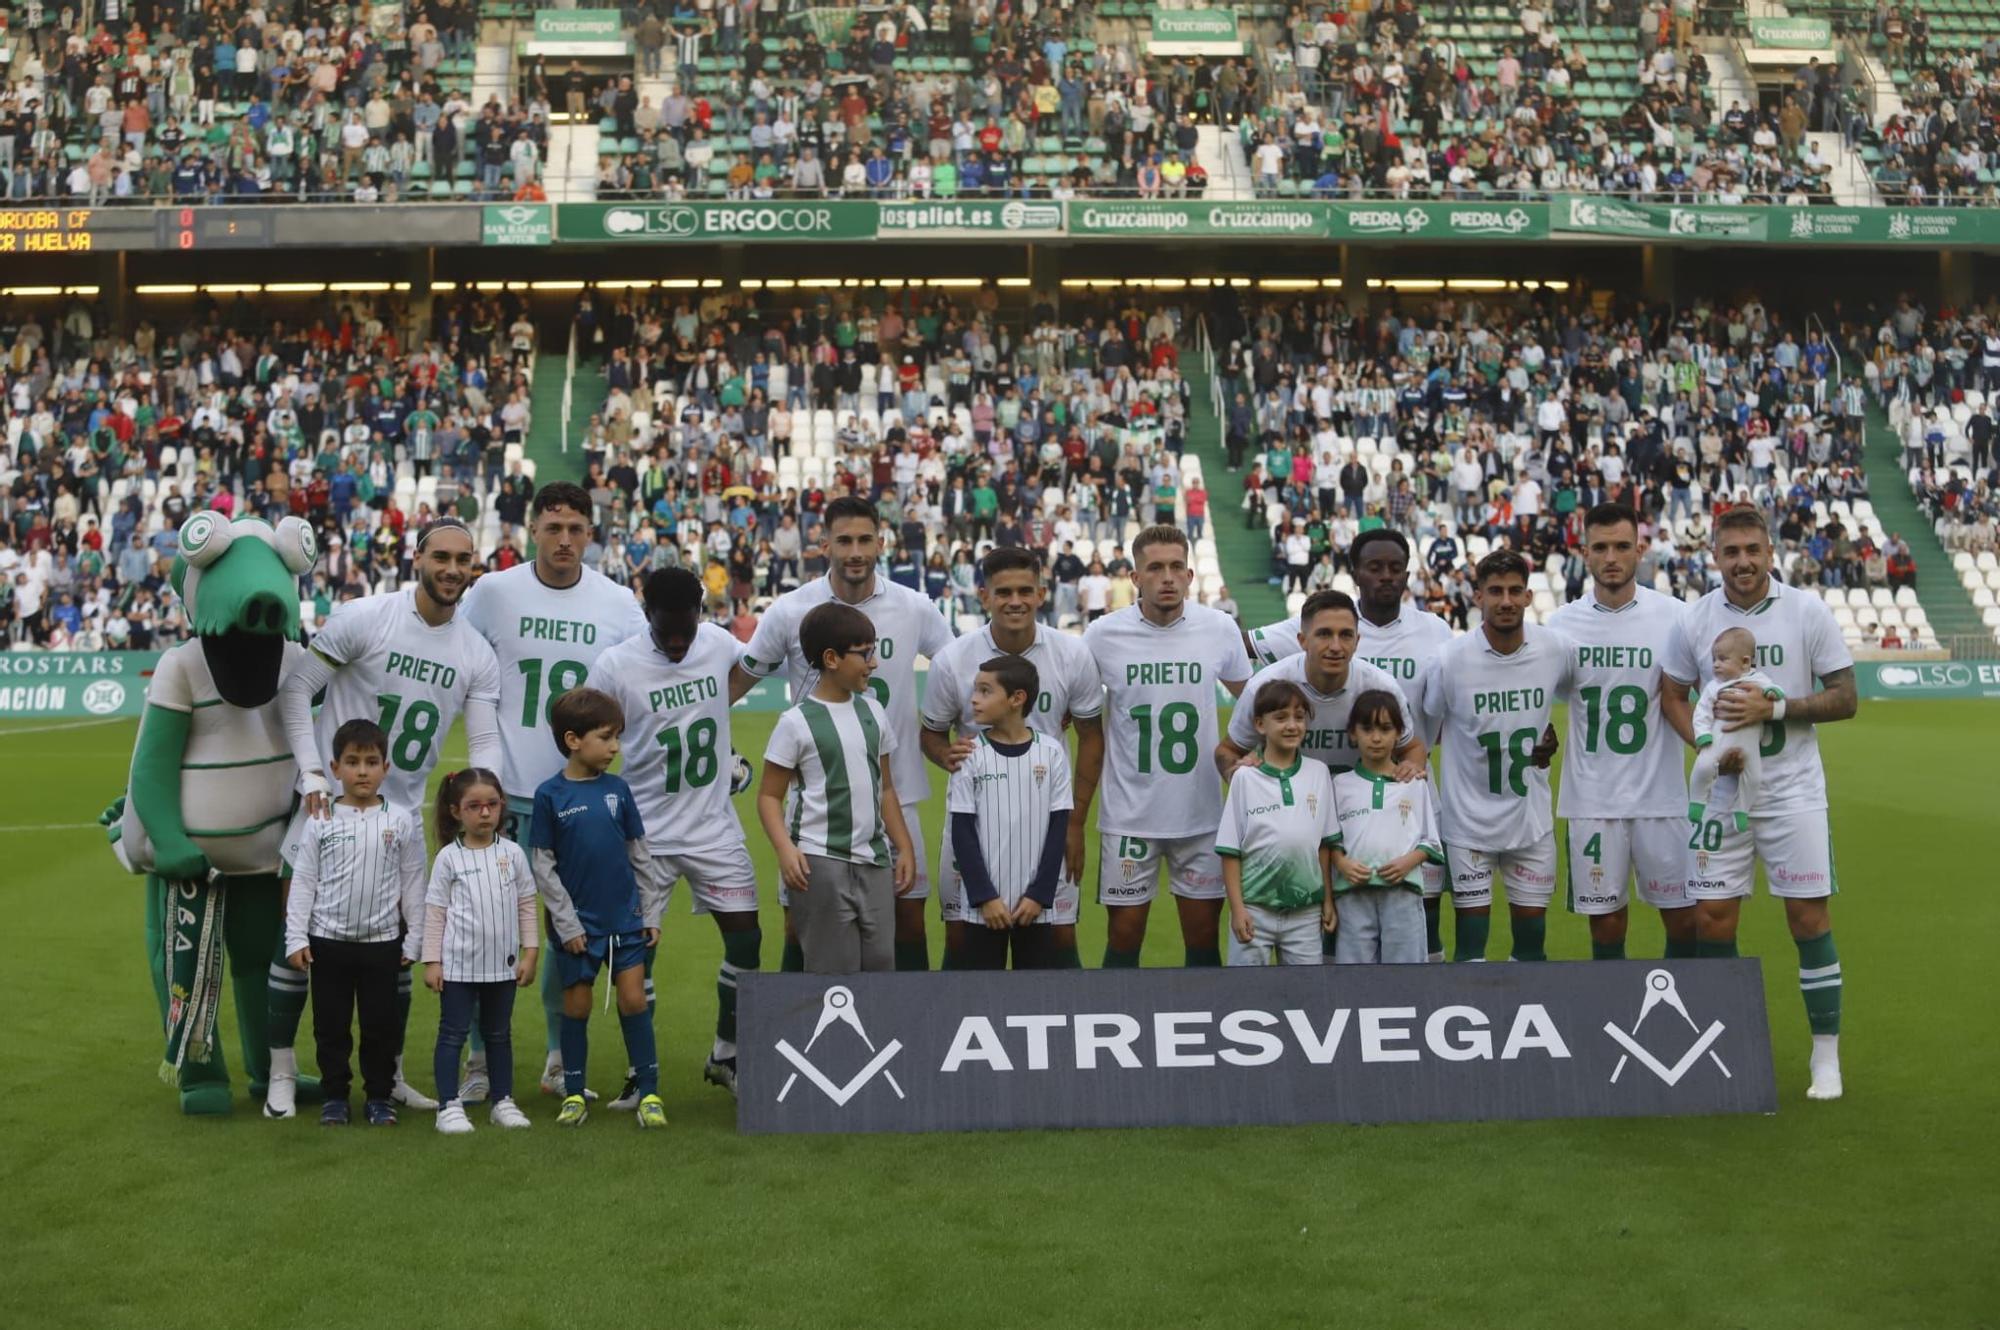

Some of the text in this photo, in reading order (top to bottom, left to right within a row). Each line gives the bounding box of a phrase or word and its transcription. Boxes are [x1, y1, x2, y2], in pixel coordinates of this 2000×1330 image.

[540, 19, 614, 34] Cruzcampo
[1159, 18, 1231, 33] Cruzcampo
[1758, 26, 1826, 41] Cruzcampo
[68, 212, 91, 228] CF
[180, 208, 193, 226] 0
[645, 209, 832, 232] LSC ERGOCOR
[1083, 209, 1188, 230] Cruzcampo
[1209, 208, 1313, 230] Cruzcampo
[1349, 212, 1402, 226] PIEDRA
[1450, 212, 1503, 226] PIEDRA
[25, 233, 91, 250] HUELVA
[180, 231, 193, 249] 0
[519, 616, 596, 645] PRIETO
[0, 656, 123, 674] ROSTARS
[1579, 647, 1652, 669] PRIETO
[385, 651, 456, 689] PRIETO
[1126, 662, 1202, 686] PRIETO
[1918, 667, 1965, 684] LSC
[0, 684, 66, 710] ACIÓN
[649, 676, 718, 713] PRIETO
[1474, 687, 1544, 714] PRIETO
[1580, 685, 1648, 755] 18
[377, 694, 440, 771] 18
[1129, 701, 1199, 774] 18
[656, 717, 718, 793] 18
[1477, 727, 1538, 797] 18
[1688, 819, 1722, 852] 20
[1583, 832, 1601, 865] 4
[1108, 887, 1147, 895] GIVOVA
[1688, 880, 1725, 888] GIVOVA
[940, 1003, 1572, 1072] ATRESVEGA
